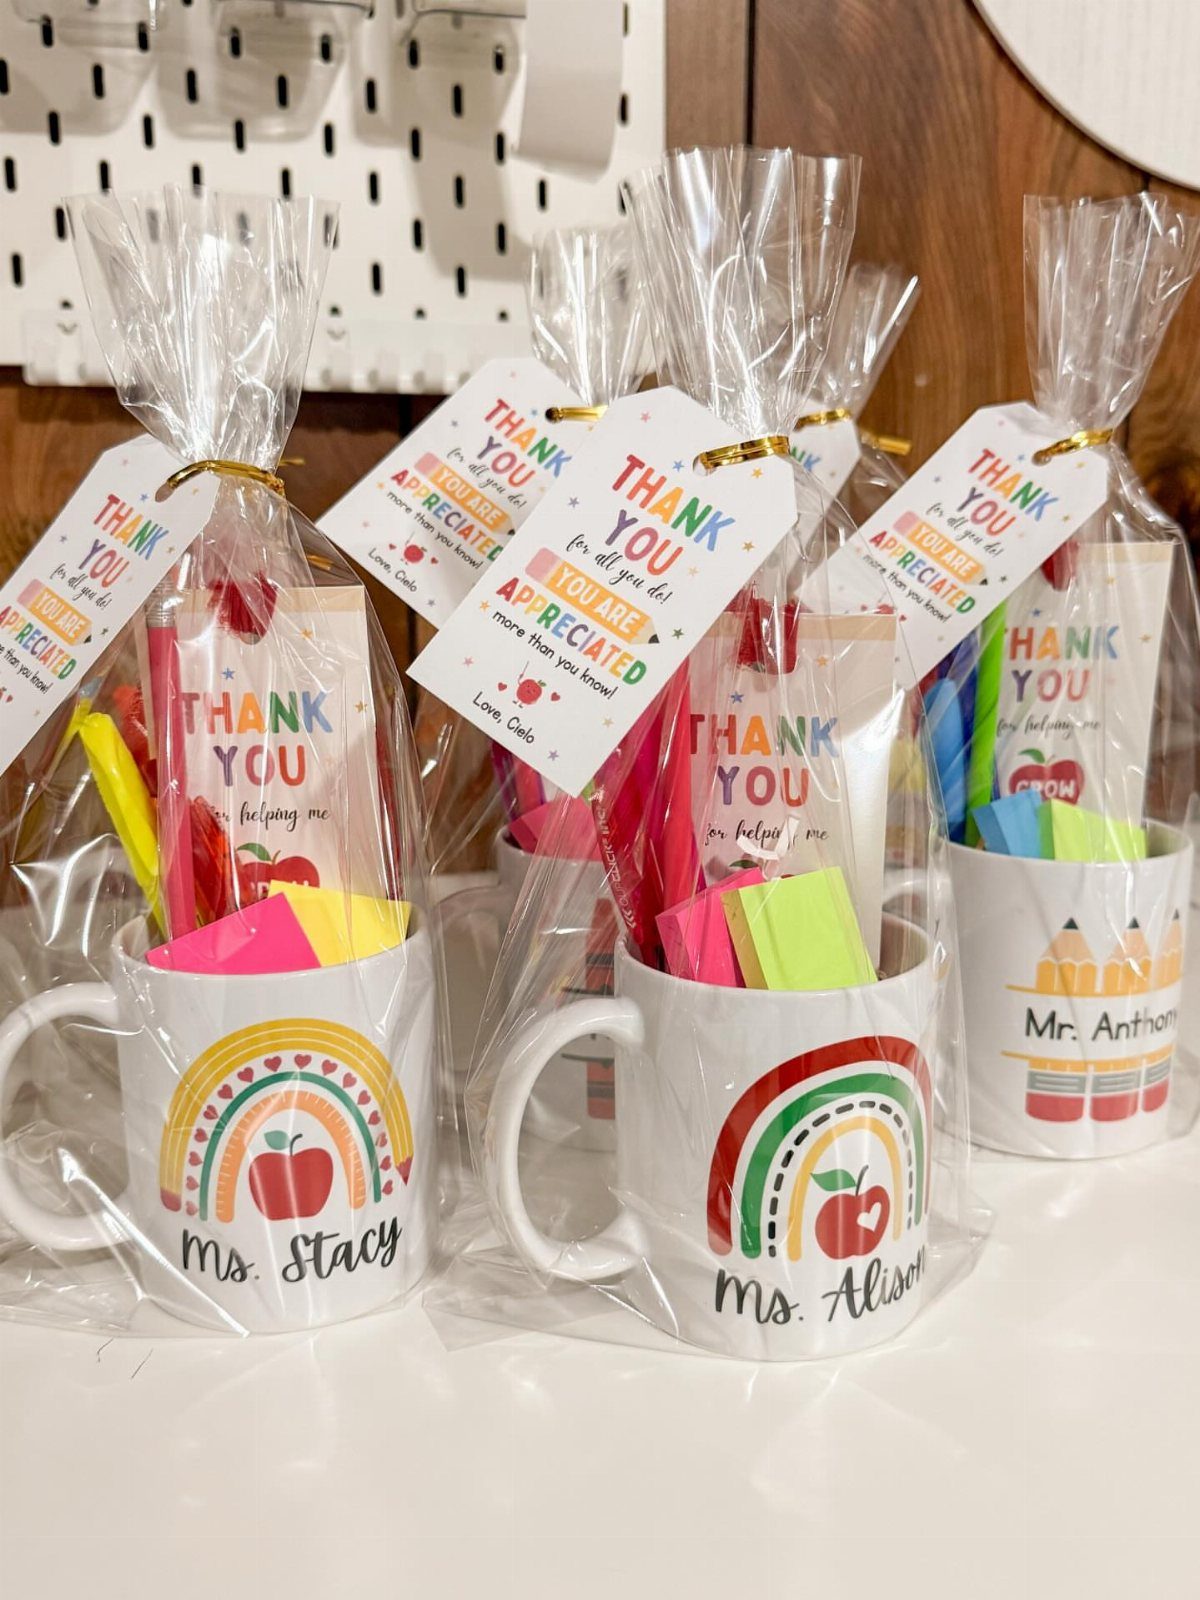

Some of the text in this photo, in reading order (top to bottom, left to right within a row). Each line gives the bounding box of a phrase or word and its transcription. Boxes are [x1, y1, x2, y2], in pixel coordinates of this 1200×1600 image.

[476, 435, 536, 488] YOU
[484, 398, 571, 478] THANK
[438, 467, 501, 525] YOU ARE
[447, 448, 528, 509] for all you do!
[611, 453, 735, 552] THANK
[968, 448, 1058, 522] THANK
[93, 493, 169, 560] THANK
[387, 491, 484, 570] more than you know!
[947, 516, 969, 531] all
[956, 486, 1016, 537] YOU
[78, 538, 130, 589] YOU
[604, 508, 683, 576] YOU
[914, 524, 975, 577] YOU ARE
[368, 547, 417, 592] Love, Cielo
[566, 533, 673, 605] for all you do!
[862, 554, 952, 623] more than you know!
[869, 530, 976, 614] APPRECIATED
[36, 590, 86, 635] YOU ARE
[556, 566, 641, 634] YOU ARE
[0, 605, 76, 680] APPRECIATED
[492, 610, 619, 700] more than you know!
[496, 576, 647, 685] APPRECIATED
[1005, 626, 1119, 660] HANK
[4, 648, 20, 668] than
[17, 664, 32, 678] you
[30, 671, 54, 694] know!
[1011, 668, 1091, 703] YOU
[180, 690, 333, 735] THANK
[472, 691, 535, 744] Love, Cielo
[689, 713, 839, 758] THANK
[1023, 714, 1074, 741] helping
[213, 745, 305, 787] YOU
[717, 765, 810, 808] YOU
[240, 801, 299, 833] helping
[308, 807, 331, 820] me
[705, 823, 727, 846] for
[805, 827, 829, 840] me
[1025, 1007, 1077, 1041] Mr.
[182, 1217, 402, 1283] Ms. Stacy
[715, 1244, 926, 1325] Ms. Alison
